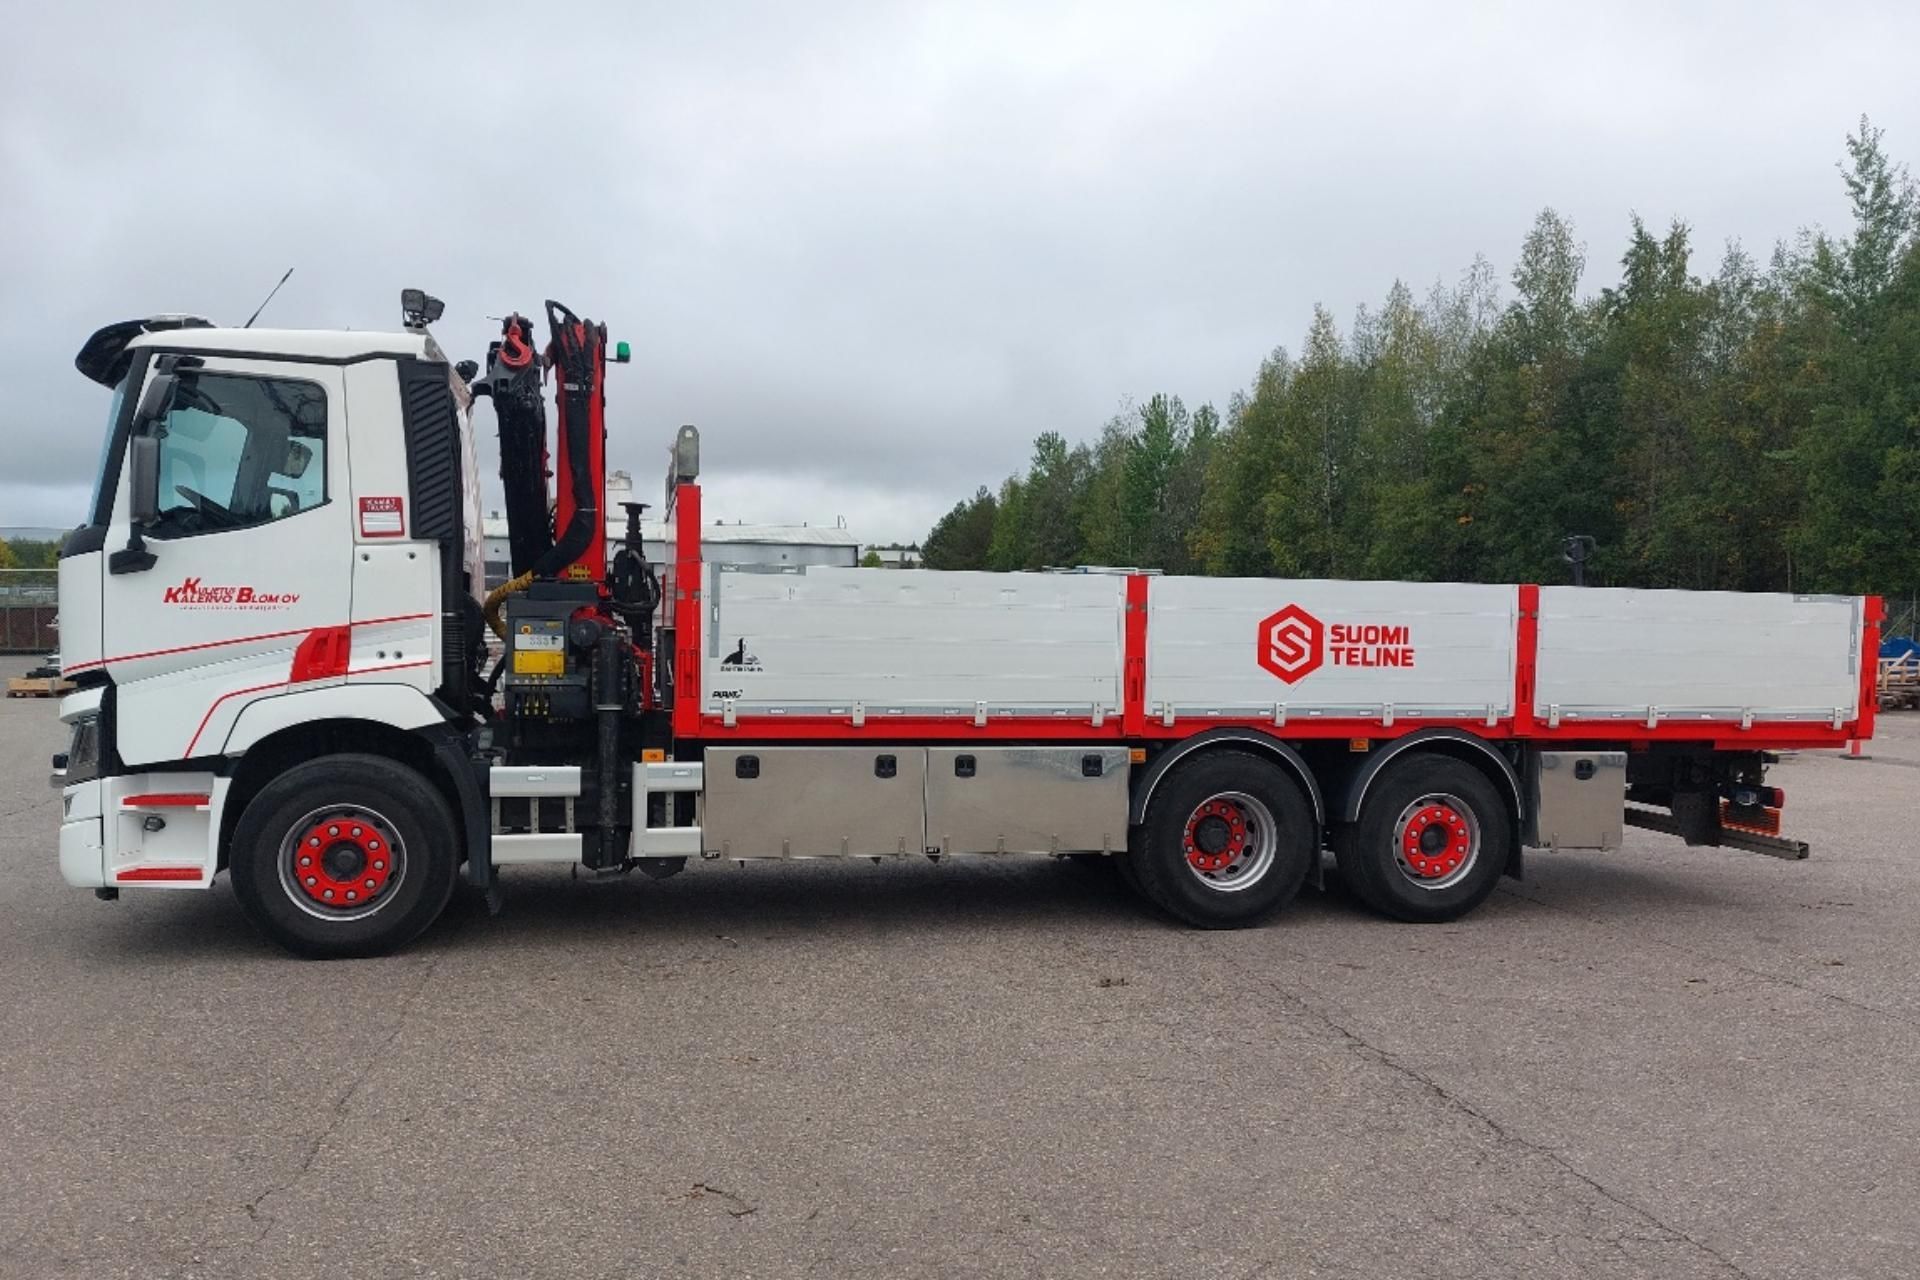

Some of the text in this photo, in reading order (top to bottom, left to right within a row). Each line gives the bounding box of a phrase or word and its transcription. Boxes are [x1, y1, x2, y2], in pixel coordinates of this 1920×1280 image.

[163, 587, 300, 603] KALERVO BLOM OY
[1330, 624, 1410, 645] SUOMI
[1330, 647, 1415, 667] TELINE
